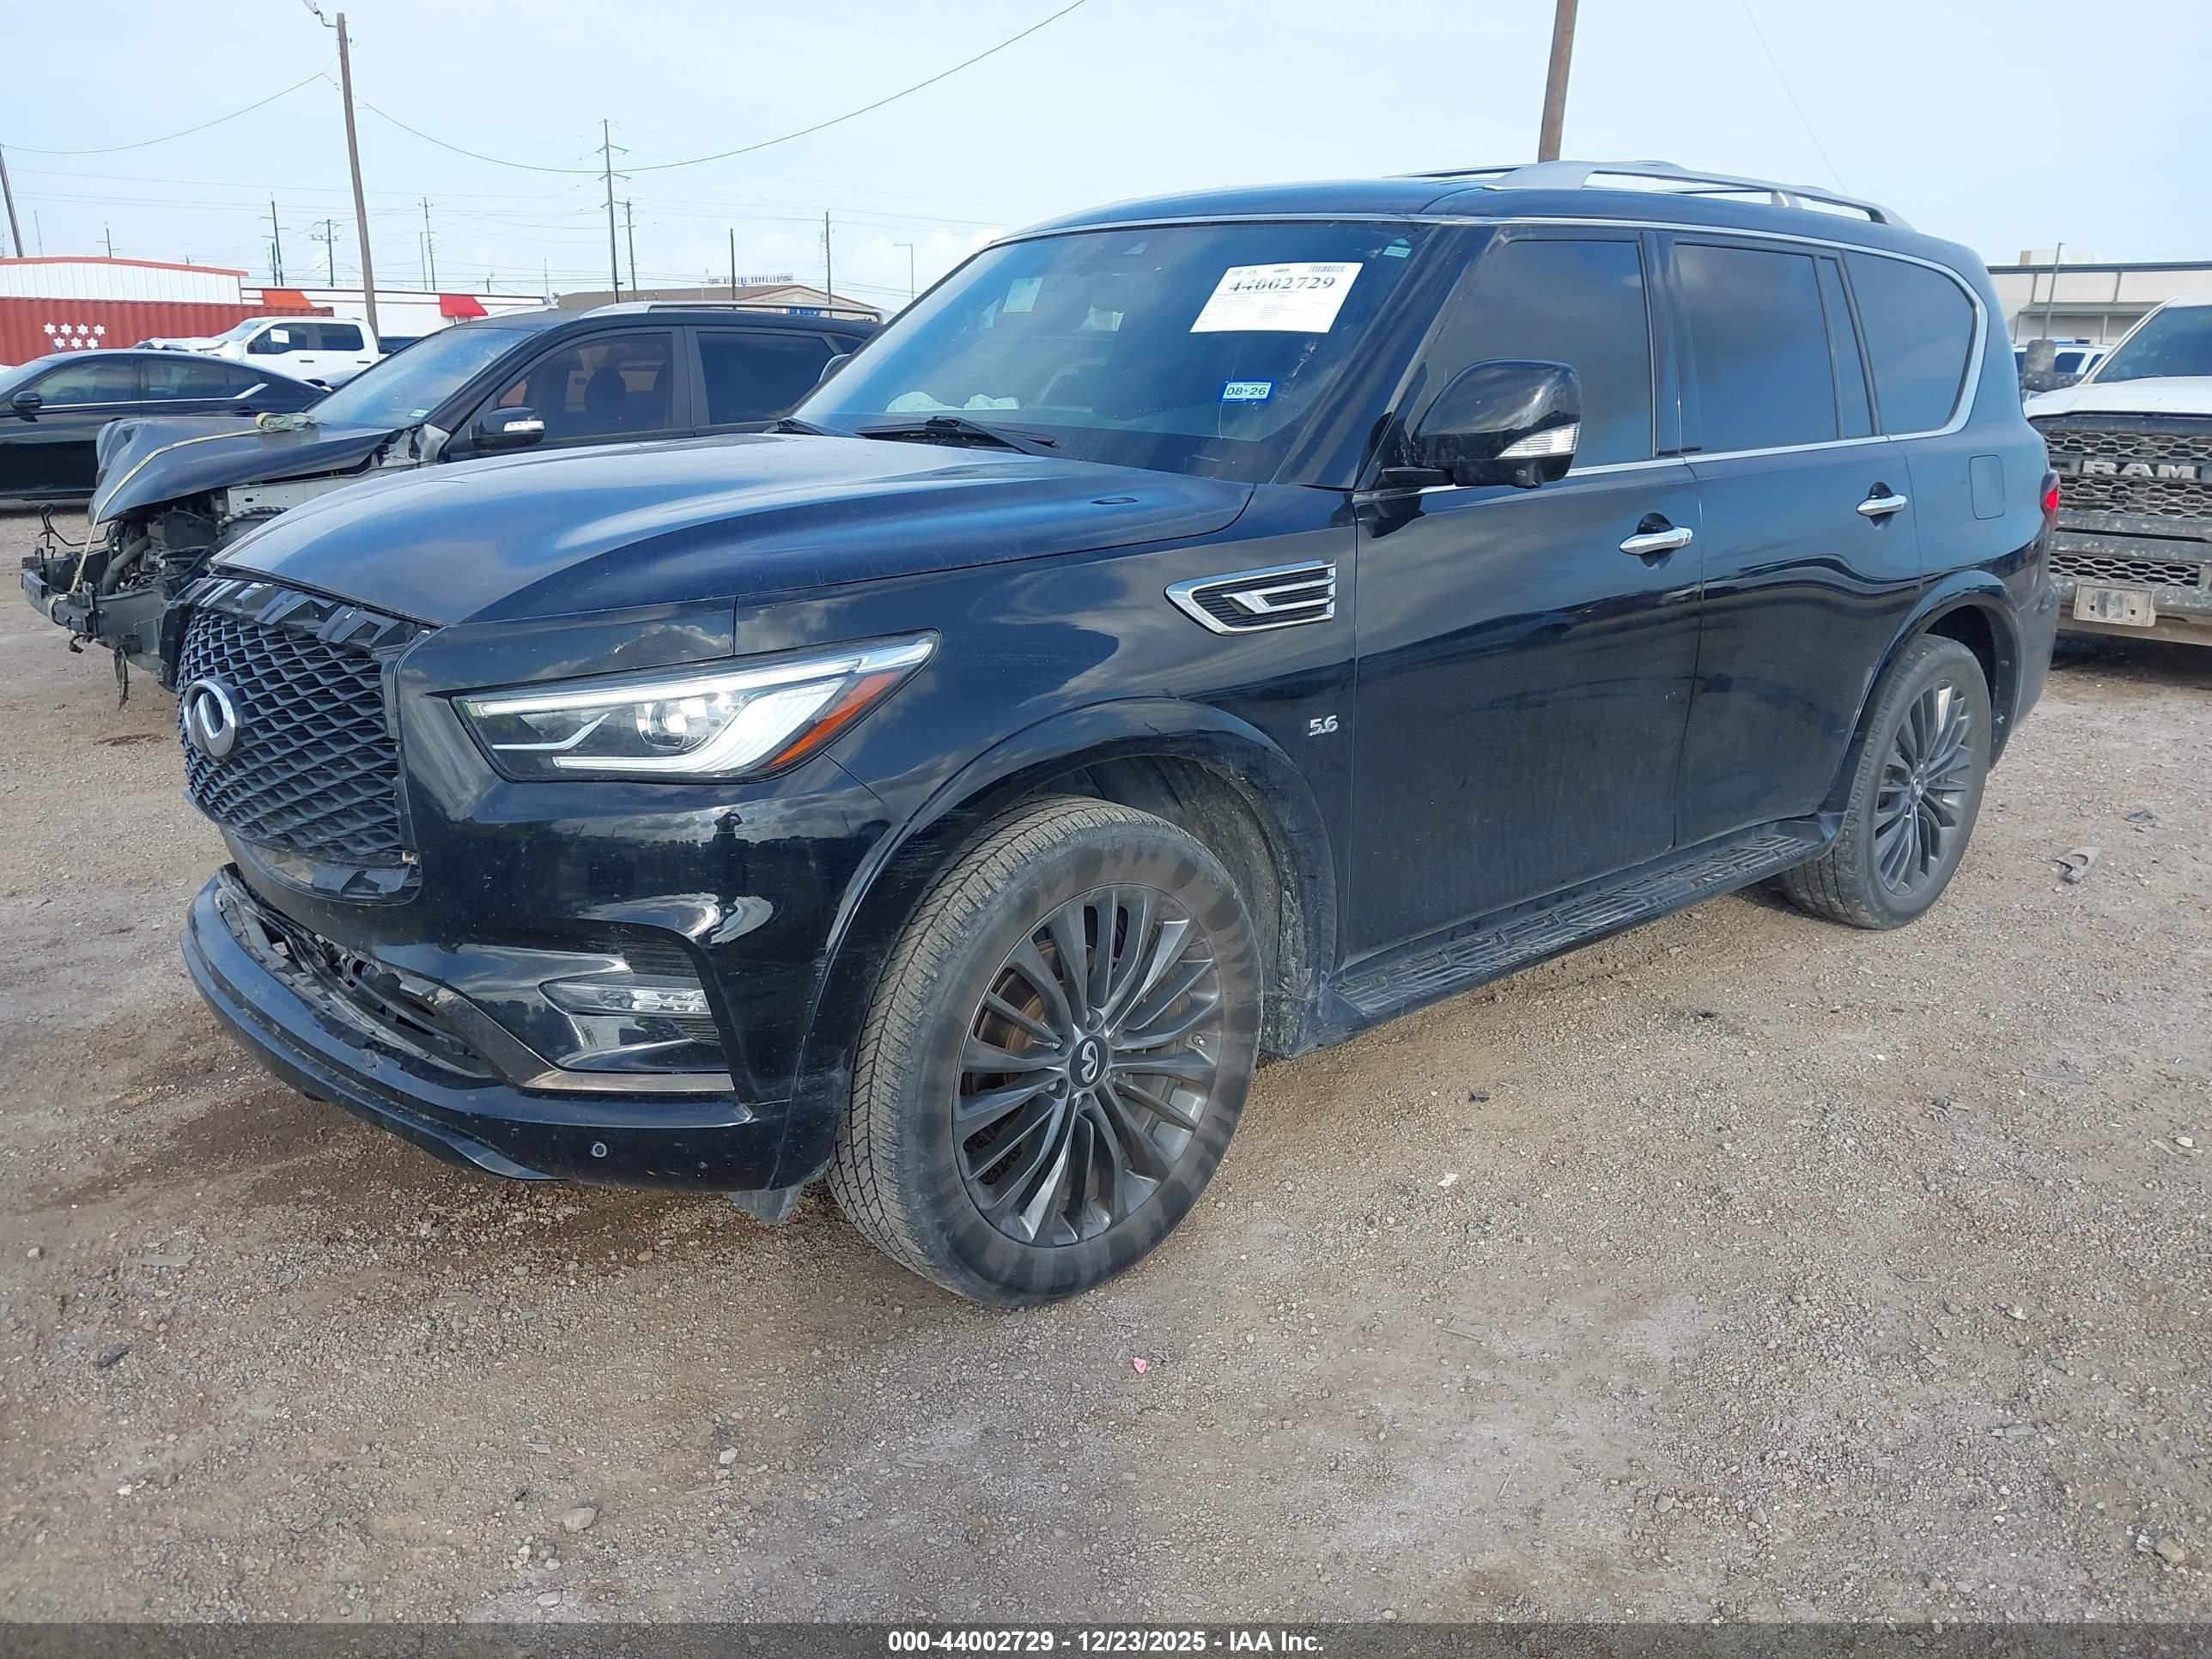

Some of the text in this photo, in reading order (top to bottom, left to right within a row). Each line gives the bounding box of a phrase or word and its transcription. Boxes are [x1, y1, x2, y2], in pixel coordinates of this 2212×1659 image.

[1229, 276, 1336, 291] 44002729
[1226, 386, 1267, 396] 08-26
[2082, 459, 2196, 479] RAM
